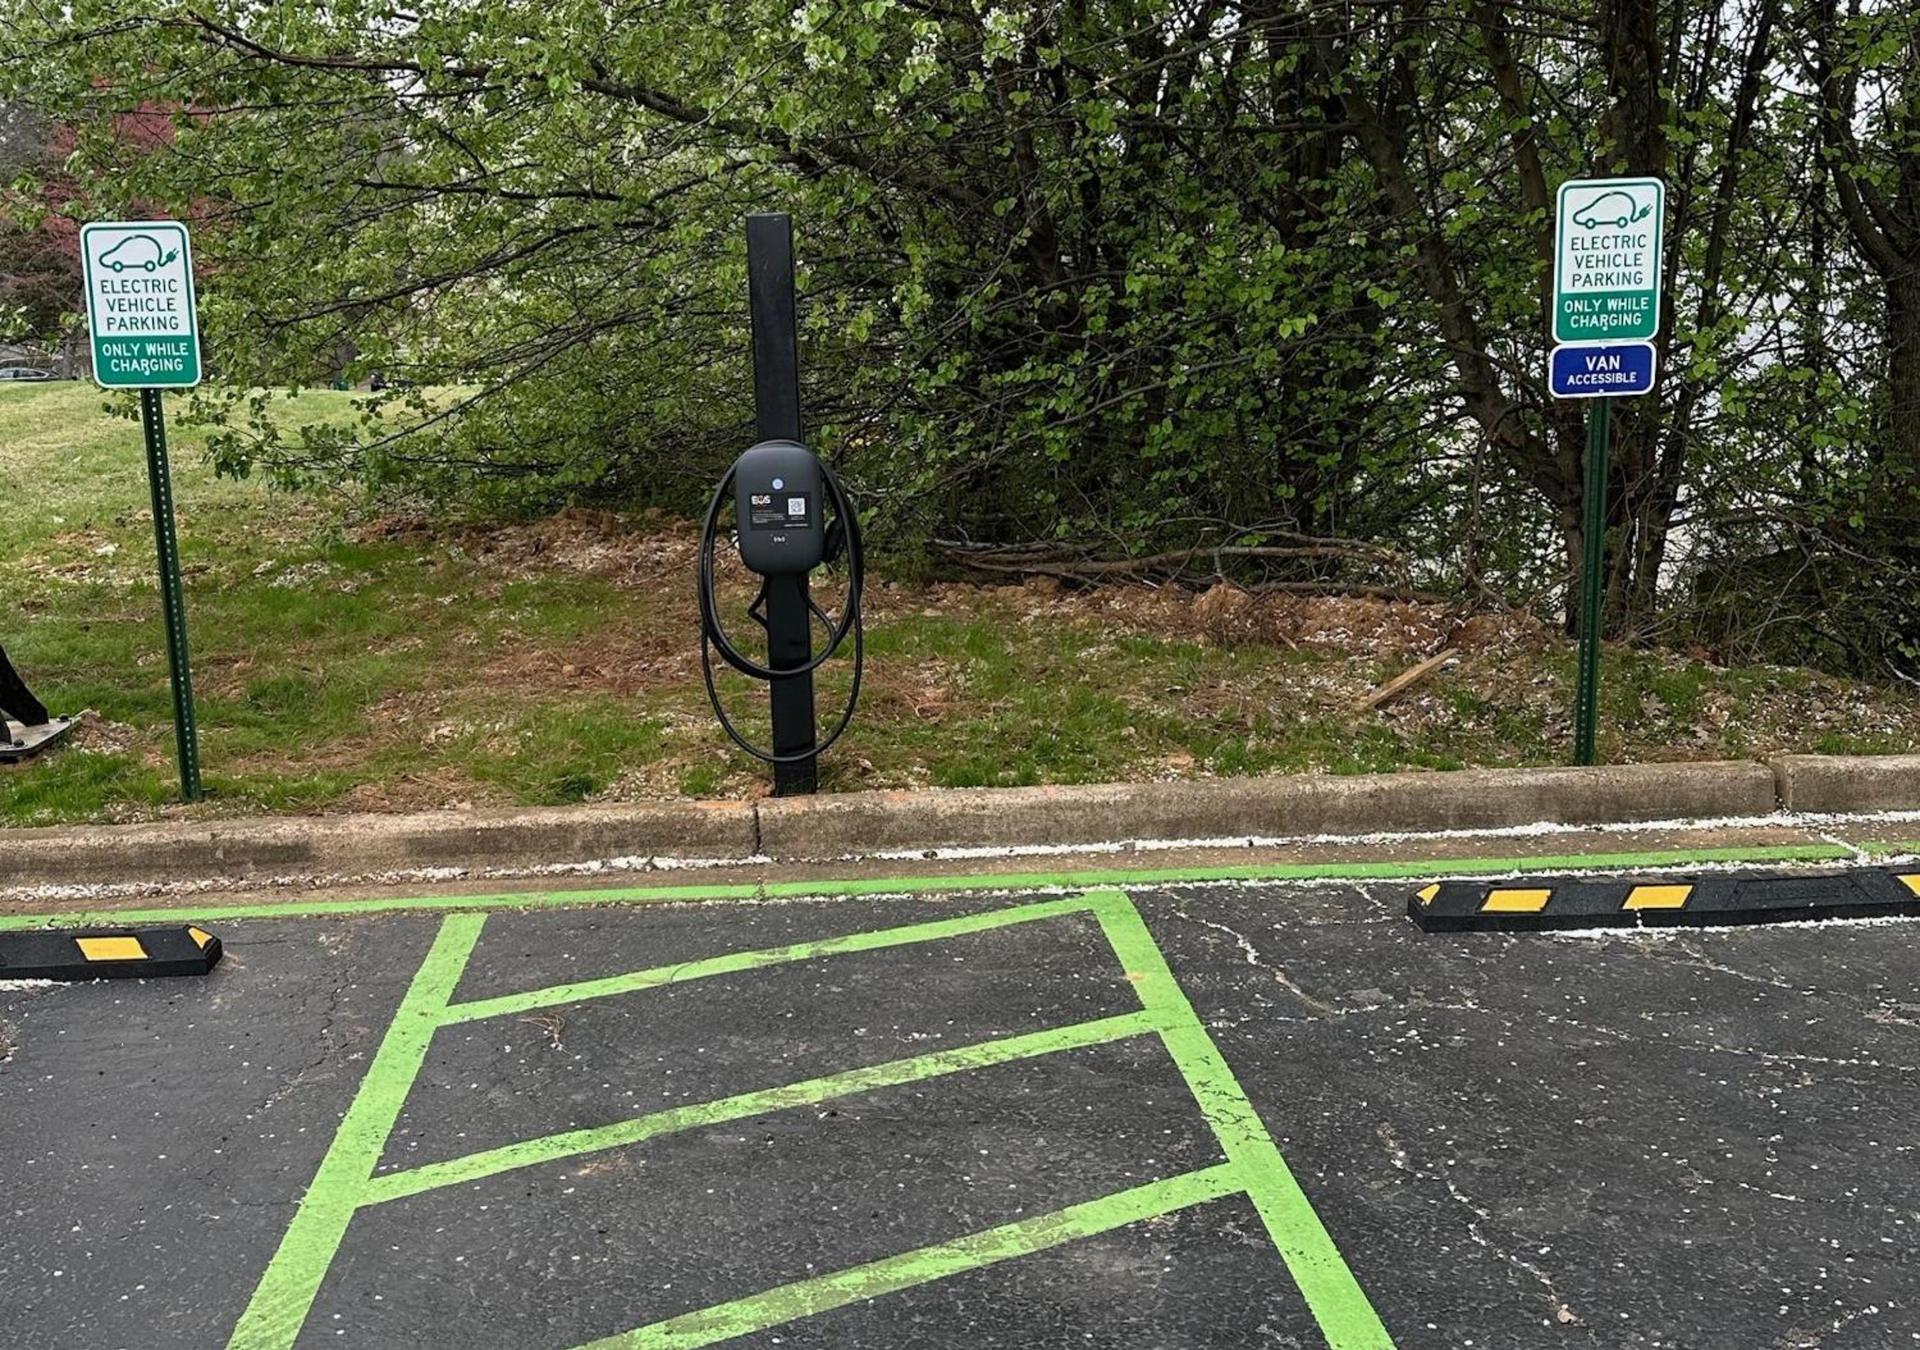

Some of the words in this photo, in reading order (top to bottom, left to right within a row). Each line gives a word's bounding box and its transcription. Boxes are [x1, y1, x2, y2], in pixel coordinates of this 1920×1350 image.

[1571, 234, 1647, 250] ELECTRIC
[1575, 253, 1643, 268] VEHICLE
[101, 279, 177, 293] ELECTRIC
[1572, 271, 1643, 287] PARKING
[107, 298, 176, 312] VEHICLE
[1564, 299, 1602, 313] ONLY
[1607, 297, 1649, 310] WHILE
[107, 316, 179, 330] PARKING
[1570, 314, 1642, 328] CHARGING
[102, 343, 140, 356] ONLY
[146, 343, 189, 355] WHILE
[110, 359, 183, 372] CHARGING
[1586, 355, 1621, 370] VAN
[1567, 372, 1637, 385] ACCESSIBLE
